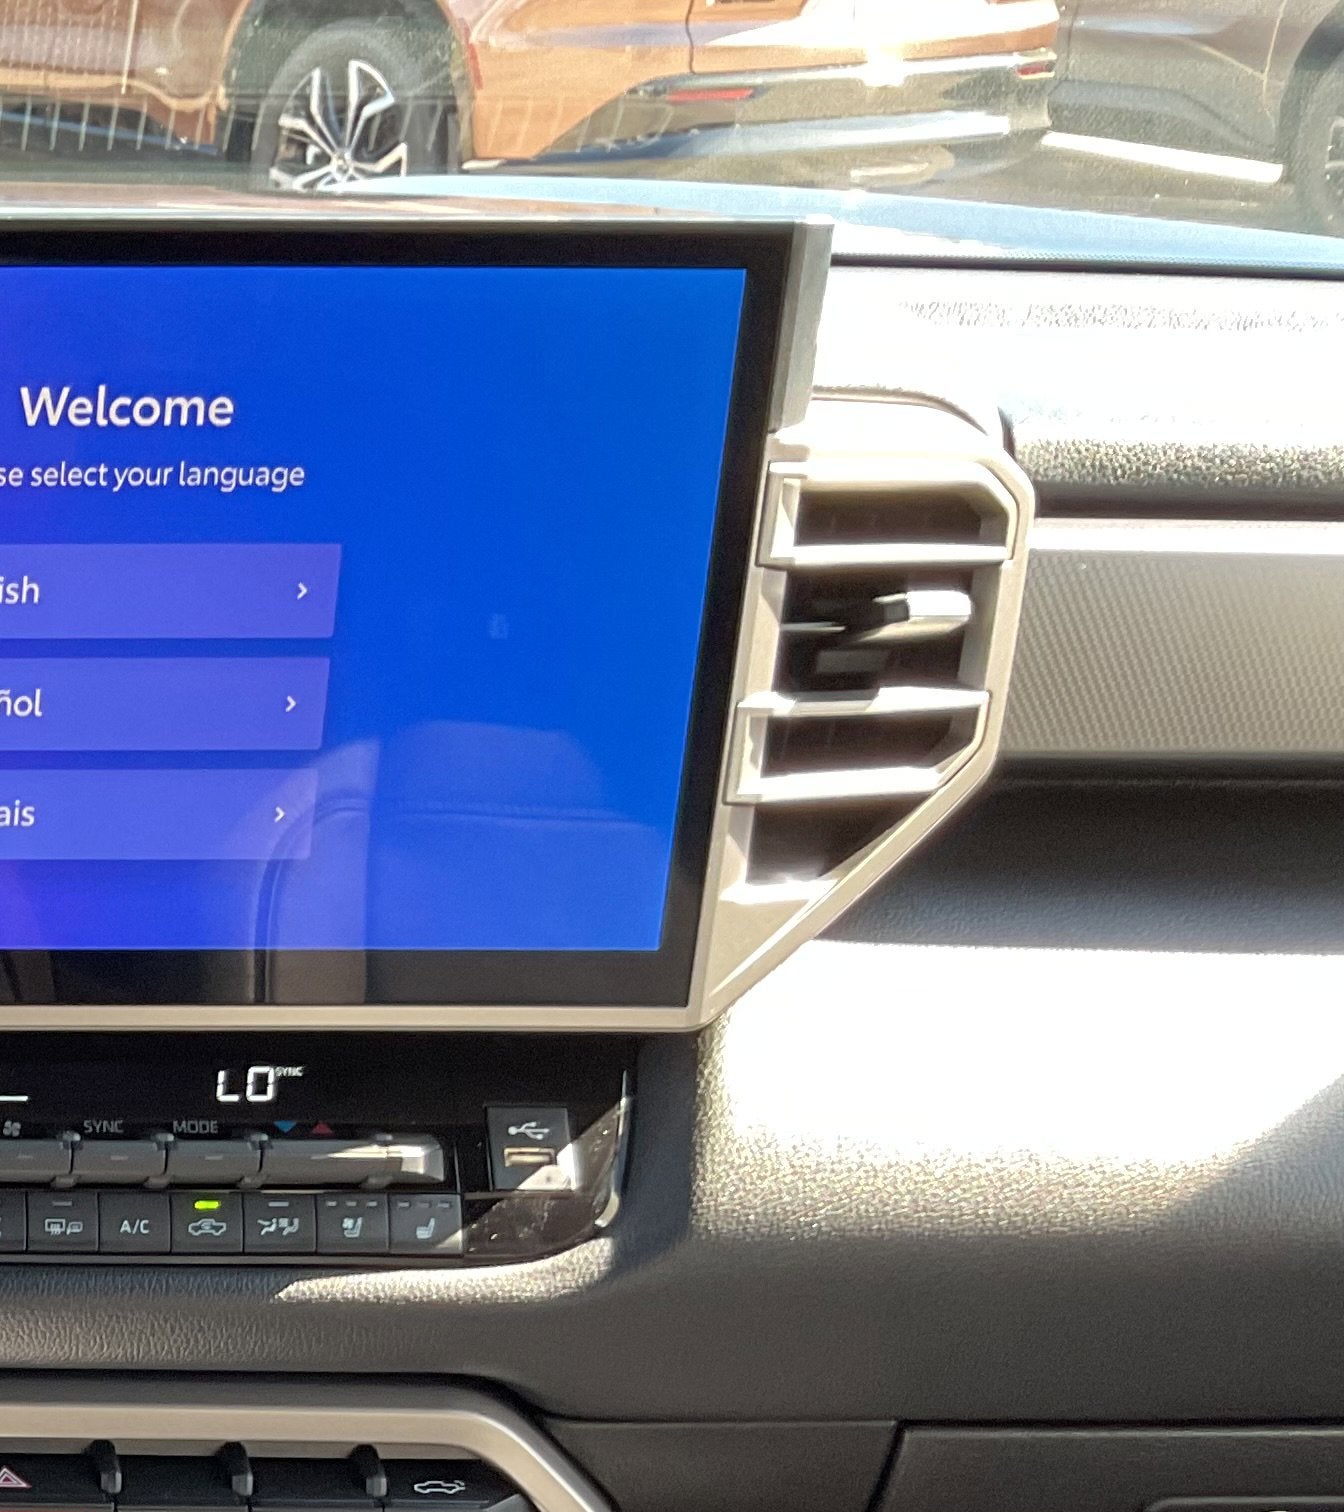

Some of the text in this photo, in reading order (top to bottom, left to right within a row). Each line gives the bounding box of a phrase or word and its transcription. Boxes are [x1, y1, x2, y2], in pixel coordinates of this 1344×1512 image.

[19, 384, 235, 427] Welcome
[30, 461, 108, 488] select
[112, 466, 174, 492] your
[178, 461, 305, 492] language
[83, 1119, 125, 1135] SYNC
[172, 1119, 219, 1135] MODE
[119, 1217, 151, 1235] A/C
